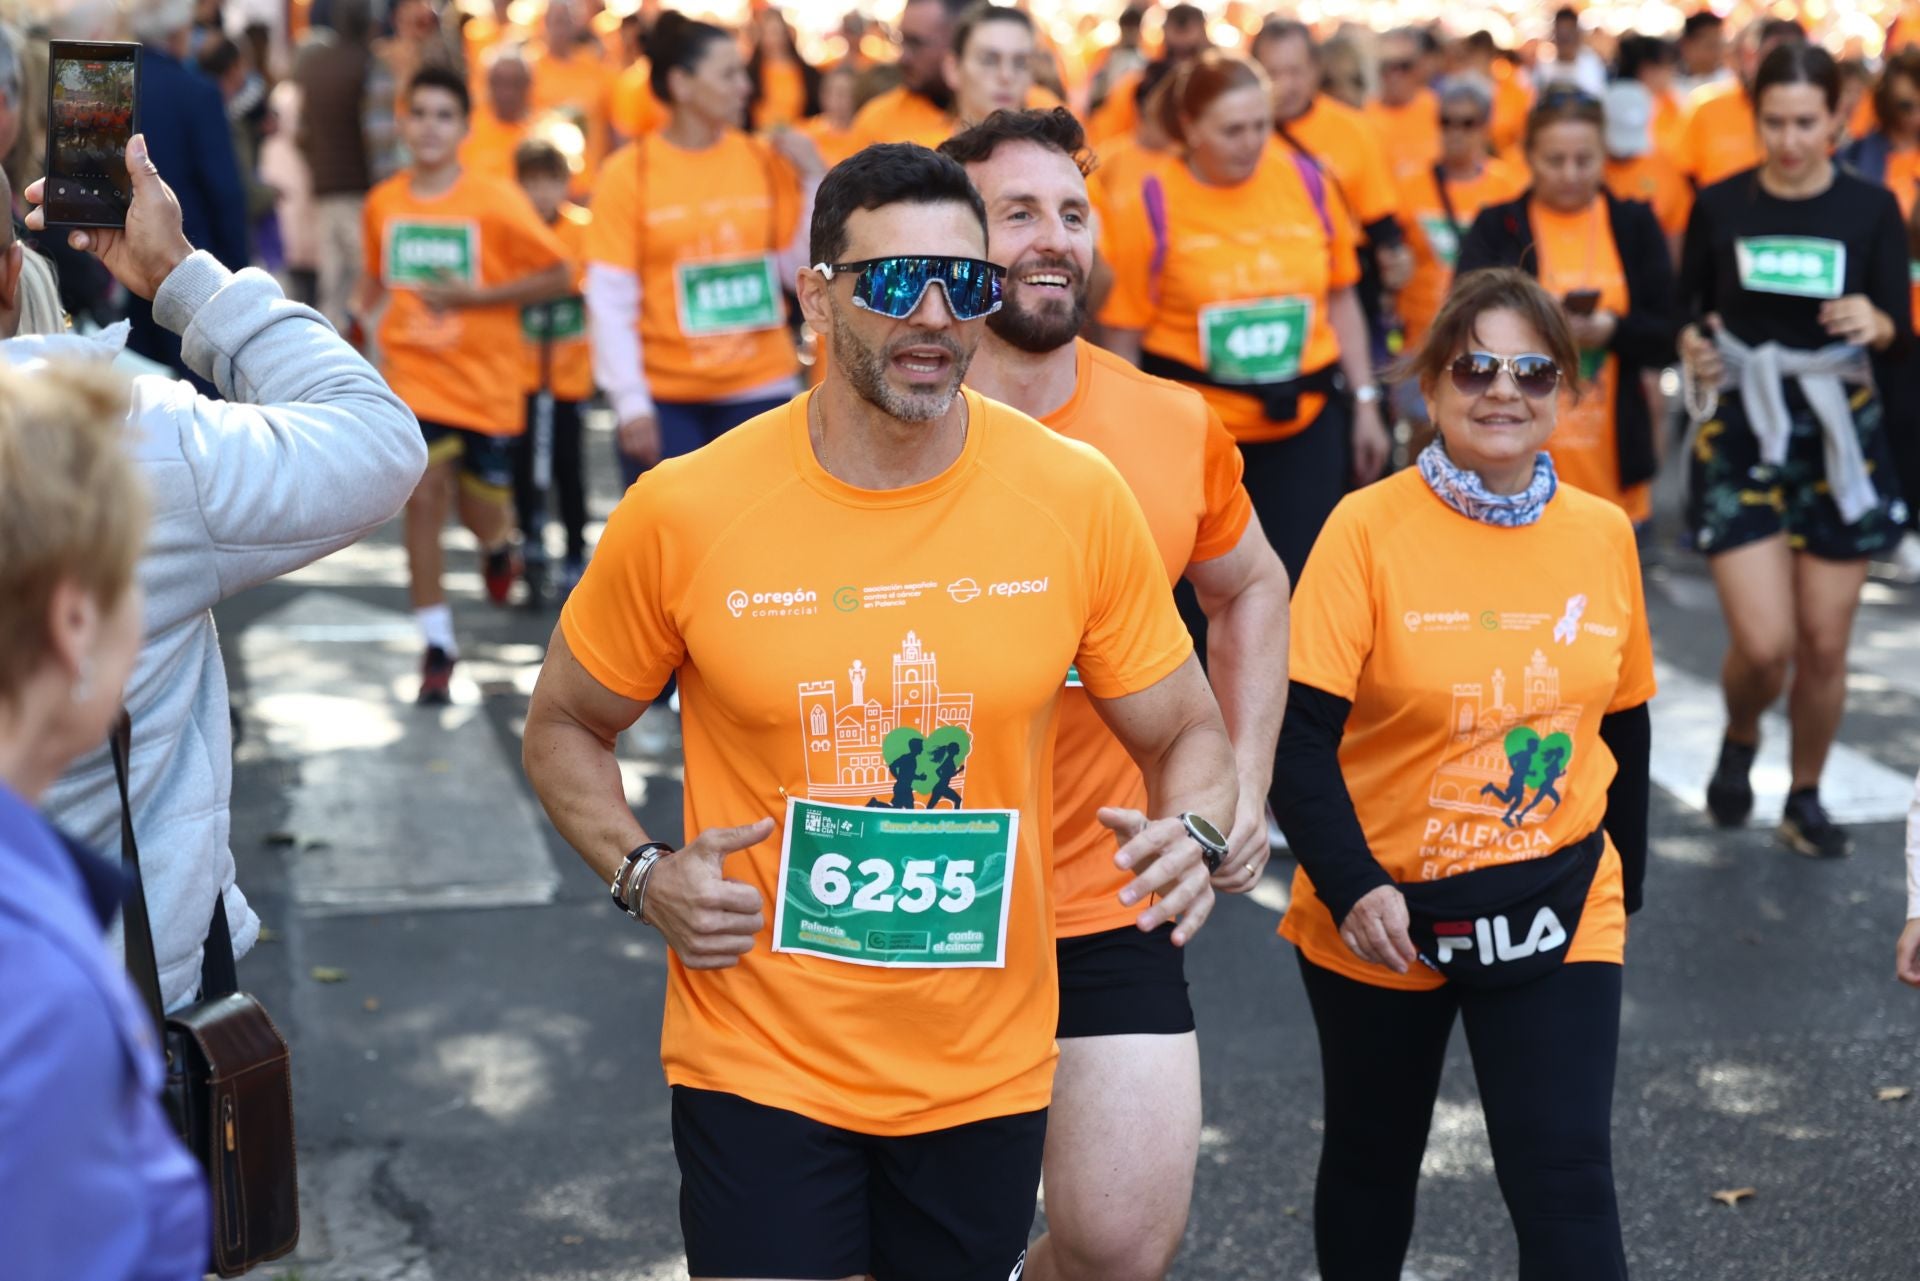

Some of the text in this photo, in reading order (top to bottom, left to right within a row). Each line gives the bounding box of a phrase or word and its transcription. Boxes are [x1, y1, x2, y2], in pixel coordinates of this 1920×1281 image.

[988, 577, 1049, 597] repsol
[753, 588, 817, 606] oregón
[752, 606, 817, 617] comercial
[1423, 818, 1552, 850] PALENCIA
[810, 853, 976, 914] 6255
[801, 920, 845, 936] Palencia
[948, 931, 983, 942] contra
[1433, 906, 1567, 966] FILA
[933, 941, 945, 951] el
[946, 941, 983, 952] cáncer
